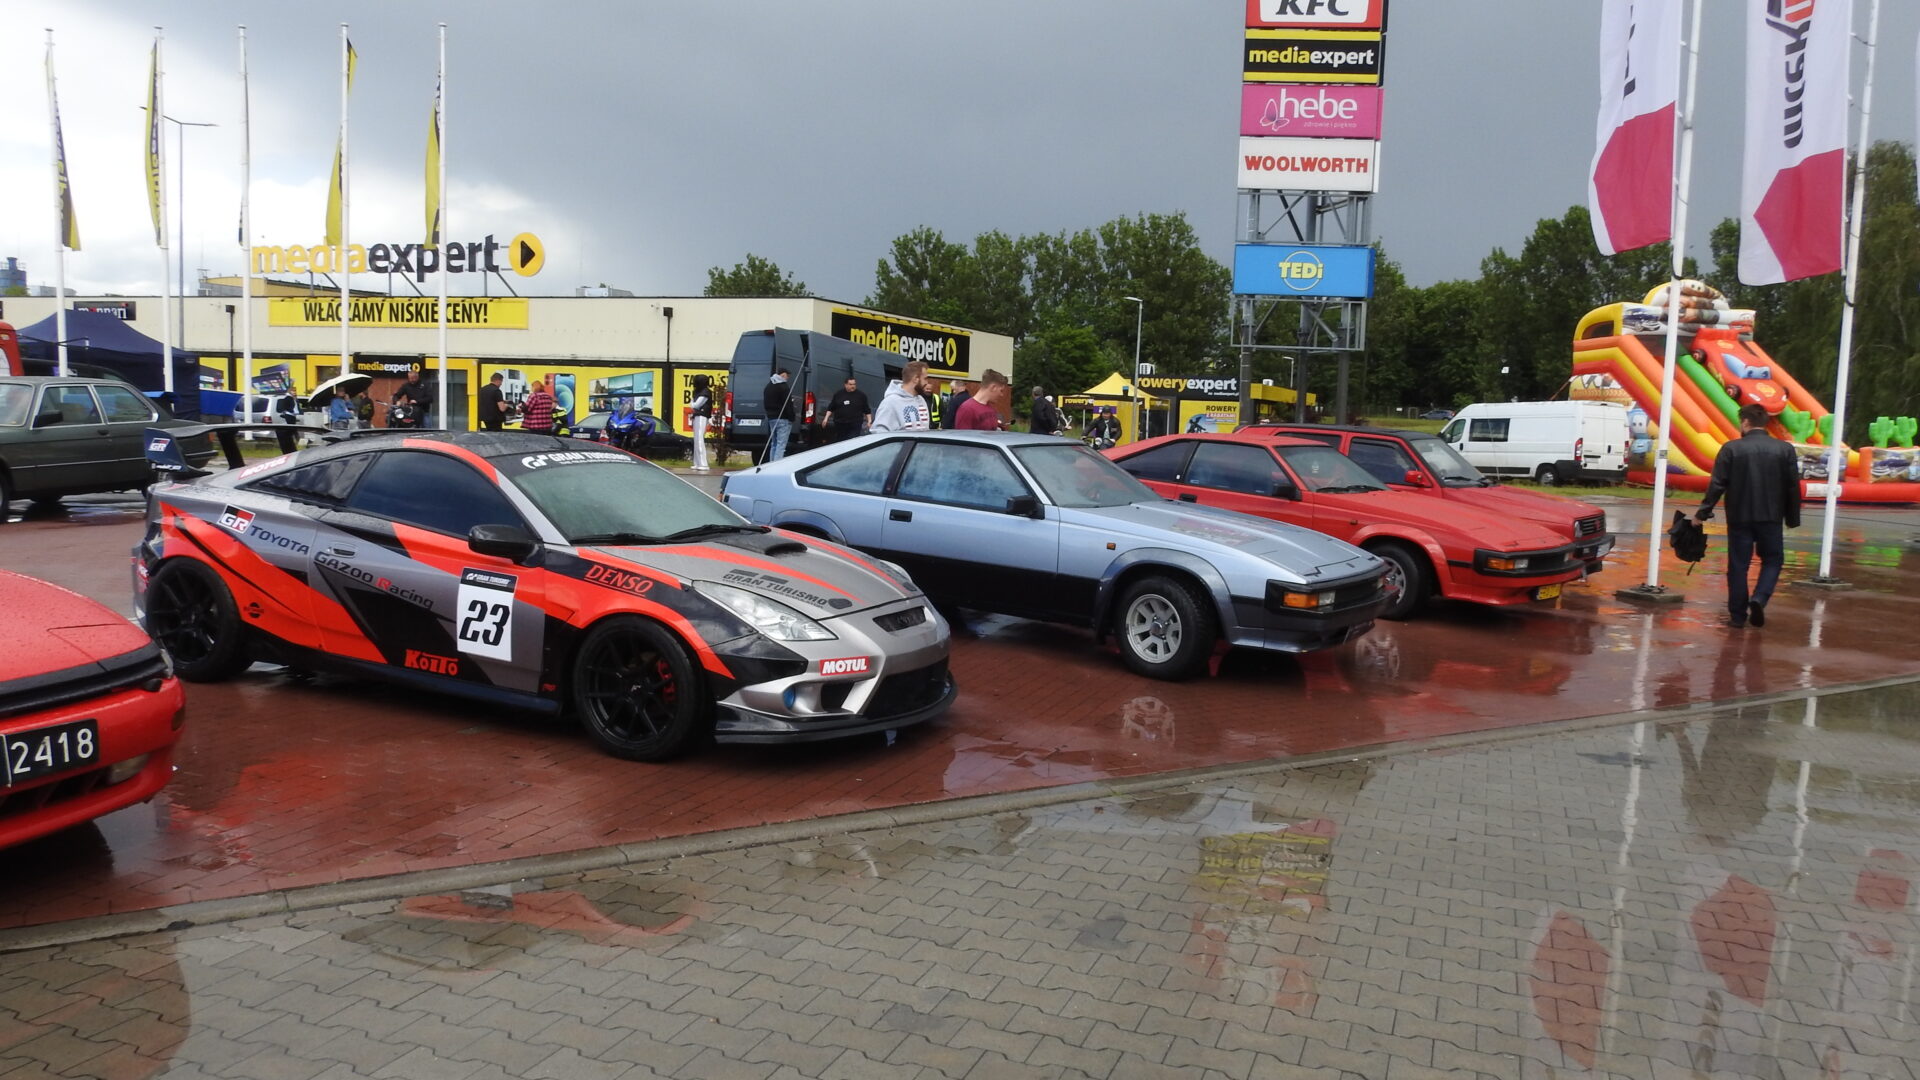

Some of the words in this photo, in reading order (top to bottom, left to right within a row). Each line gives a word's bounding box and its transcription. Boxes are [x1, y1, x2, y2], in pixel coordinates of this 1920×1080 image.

[1276, 0, 1349, 16] KFC
[1249, 46, 1374, 67] mediaexpert
[1280, 88, 1358, 119] hebe
[1245, 155, 1368, 173] WOOLWORTH
[252, 234, 499, 283] mediaexpert
[1278, 261, 1324, 279] TEDi
[850, 325, 944, 362] mediaexpert
[357, 361, 412, 373] mediaexpert
[1137, 377, 1237, 393] roweryexpert
[548, 453, 583, 462] GRAN
[220, 514, 250, 530] GR
[250, 525, 310, 556] TOYOTA
[314, 551, 374, 584] GAZOO
[375, 577, 434, 611] Racing
[585, 564, 654, 594] DENSO
[722, 573, 764, 586] GRAN
[766, 582, 828, 605] TURISMO
[459, 599, 510, 646] 23
[822, 658, 868, 674] MOTUL
[10, 728, 94, 774] 2418
